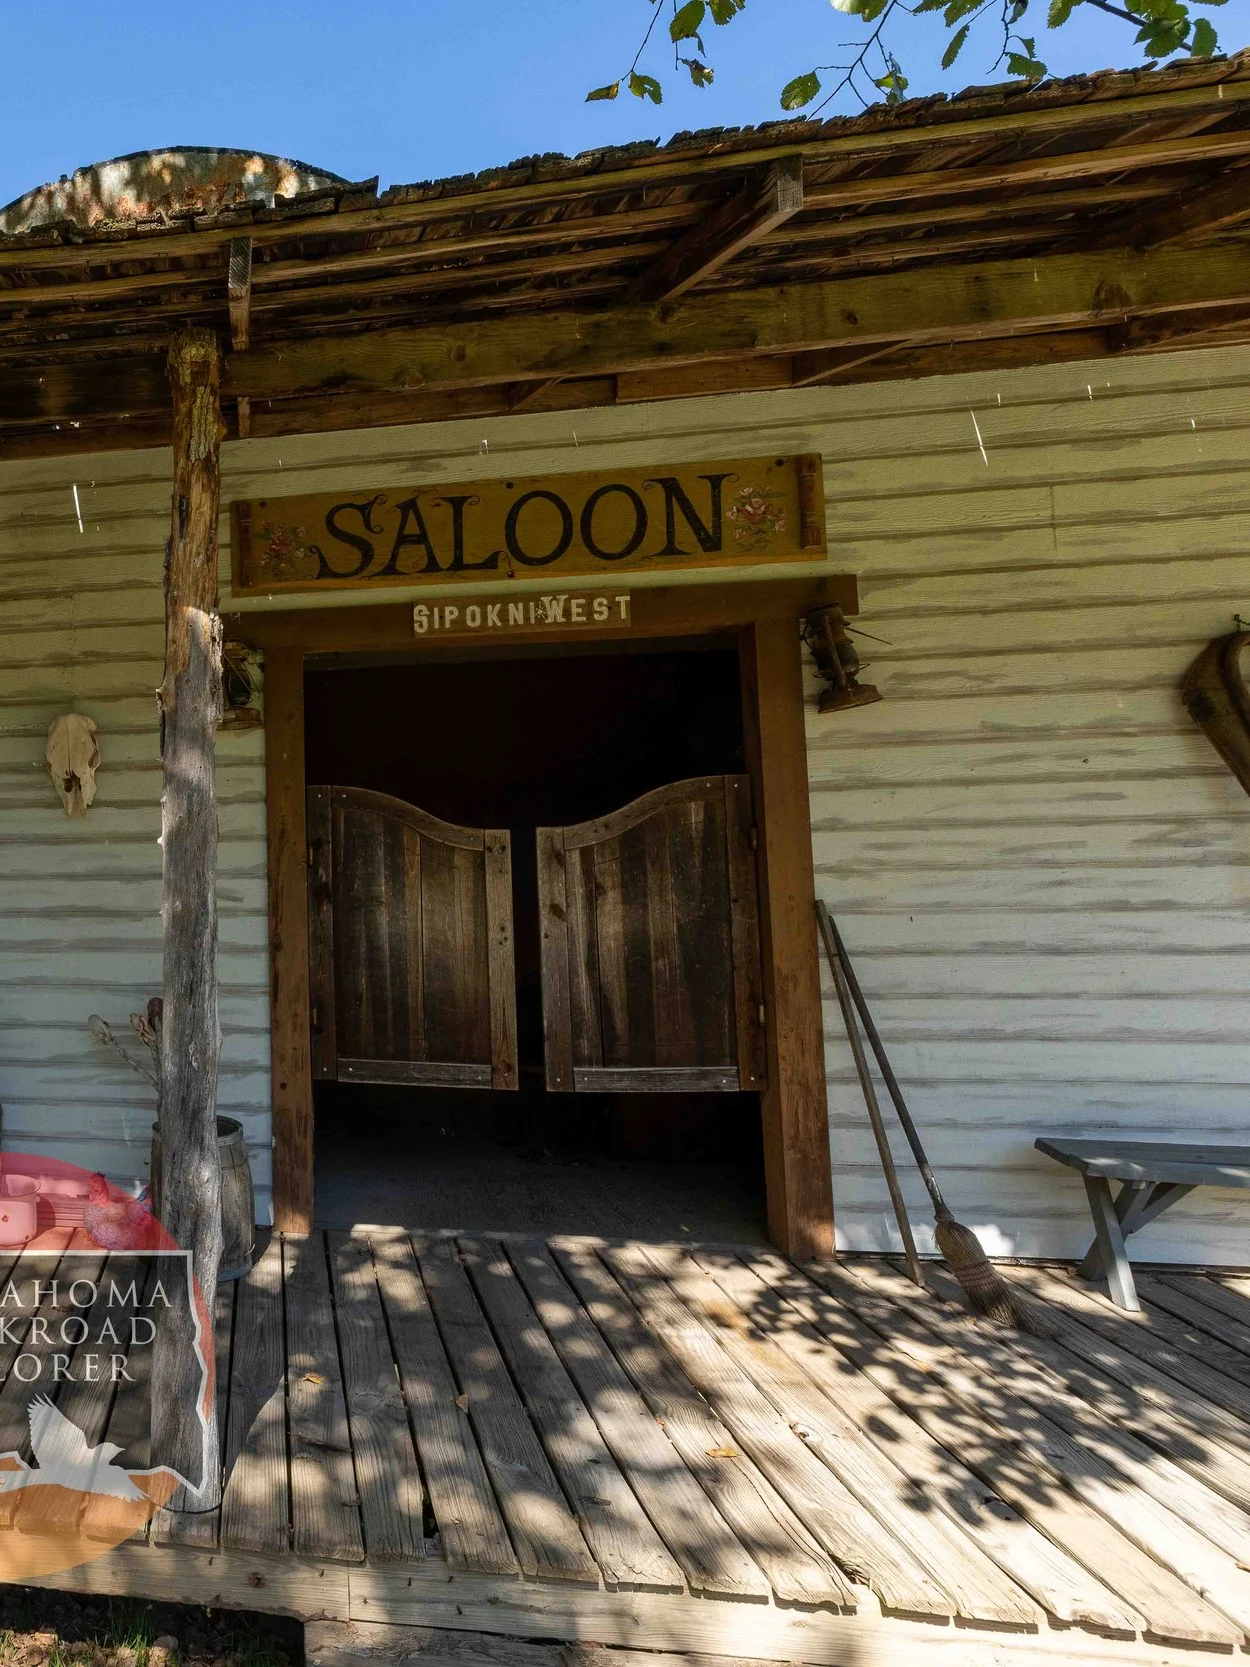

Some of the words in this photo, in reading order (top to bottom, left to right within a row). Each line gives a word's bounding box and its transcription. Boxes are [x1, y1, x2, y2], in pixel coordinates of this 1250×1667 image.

[309, 473, 738, 578] SALOON
[413, 600, 536, 633] SIPOKNI
[540, 595, 631, 624] WEST
